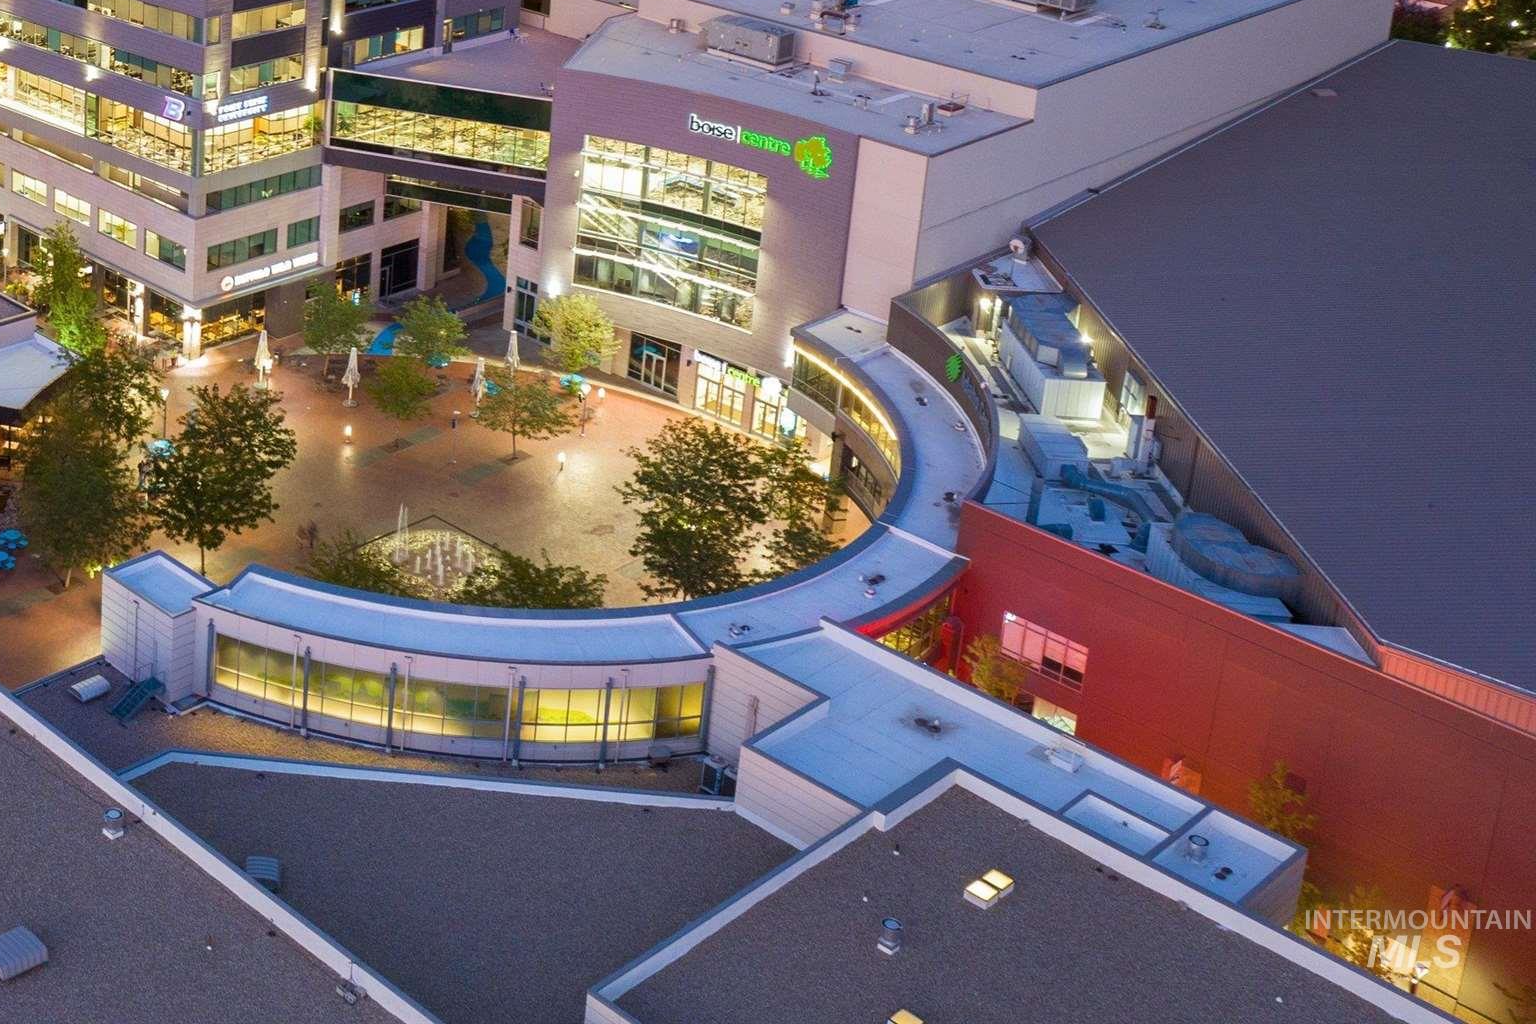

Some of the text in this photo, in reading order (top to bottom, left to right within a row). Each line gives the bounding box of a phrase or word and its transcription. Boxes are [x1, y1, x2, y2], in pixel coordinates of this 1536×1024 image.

[163, 95, 185, 121] B
[689, 113, 792, 156] boise centre
[727, 366, 761, 388] centre
